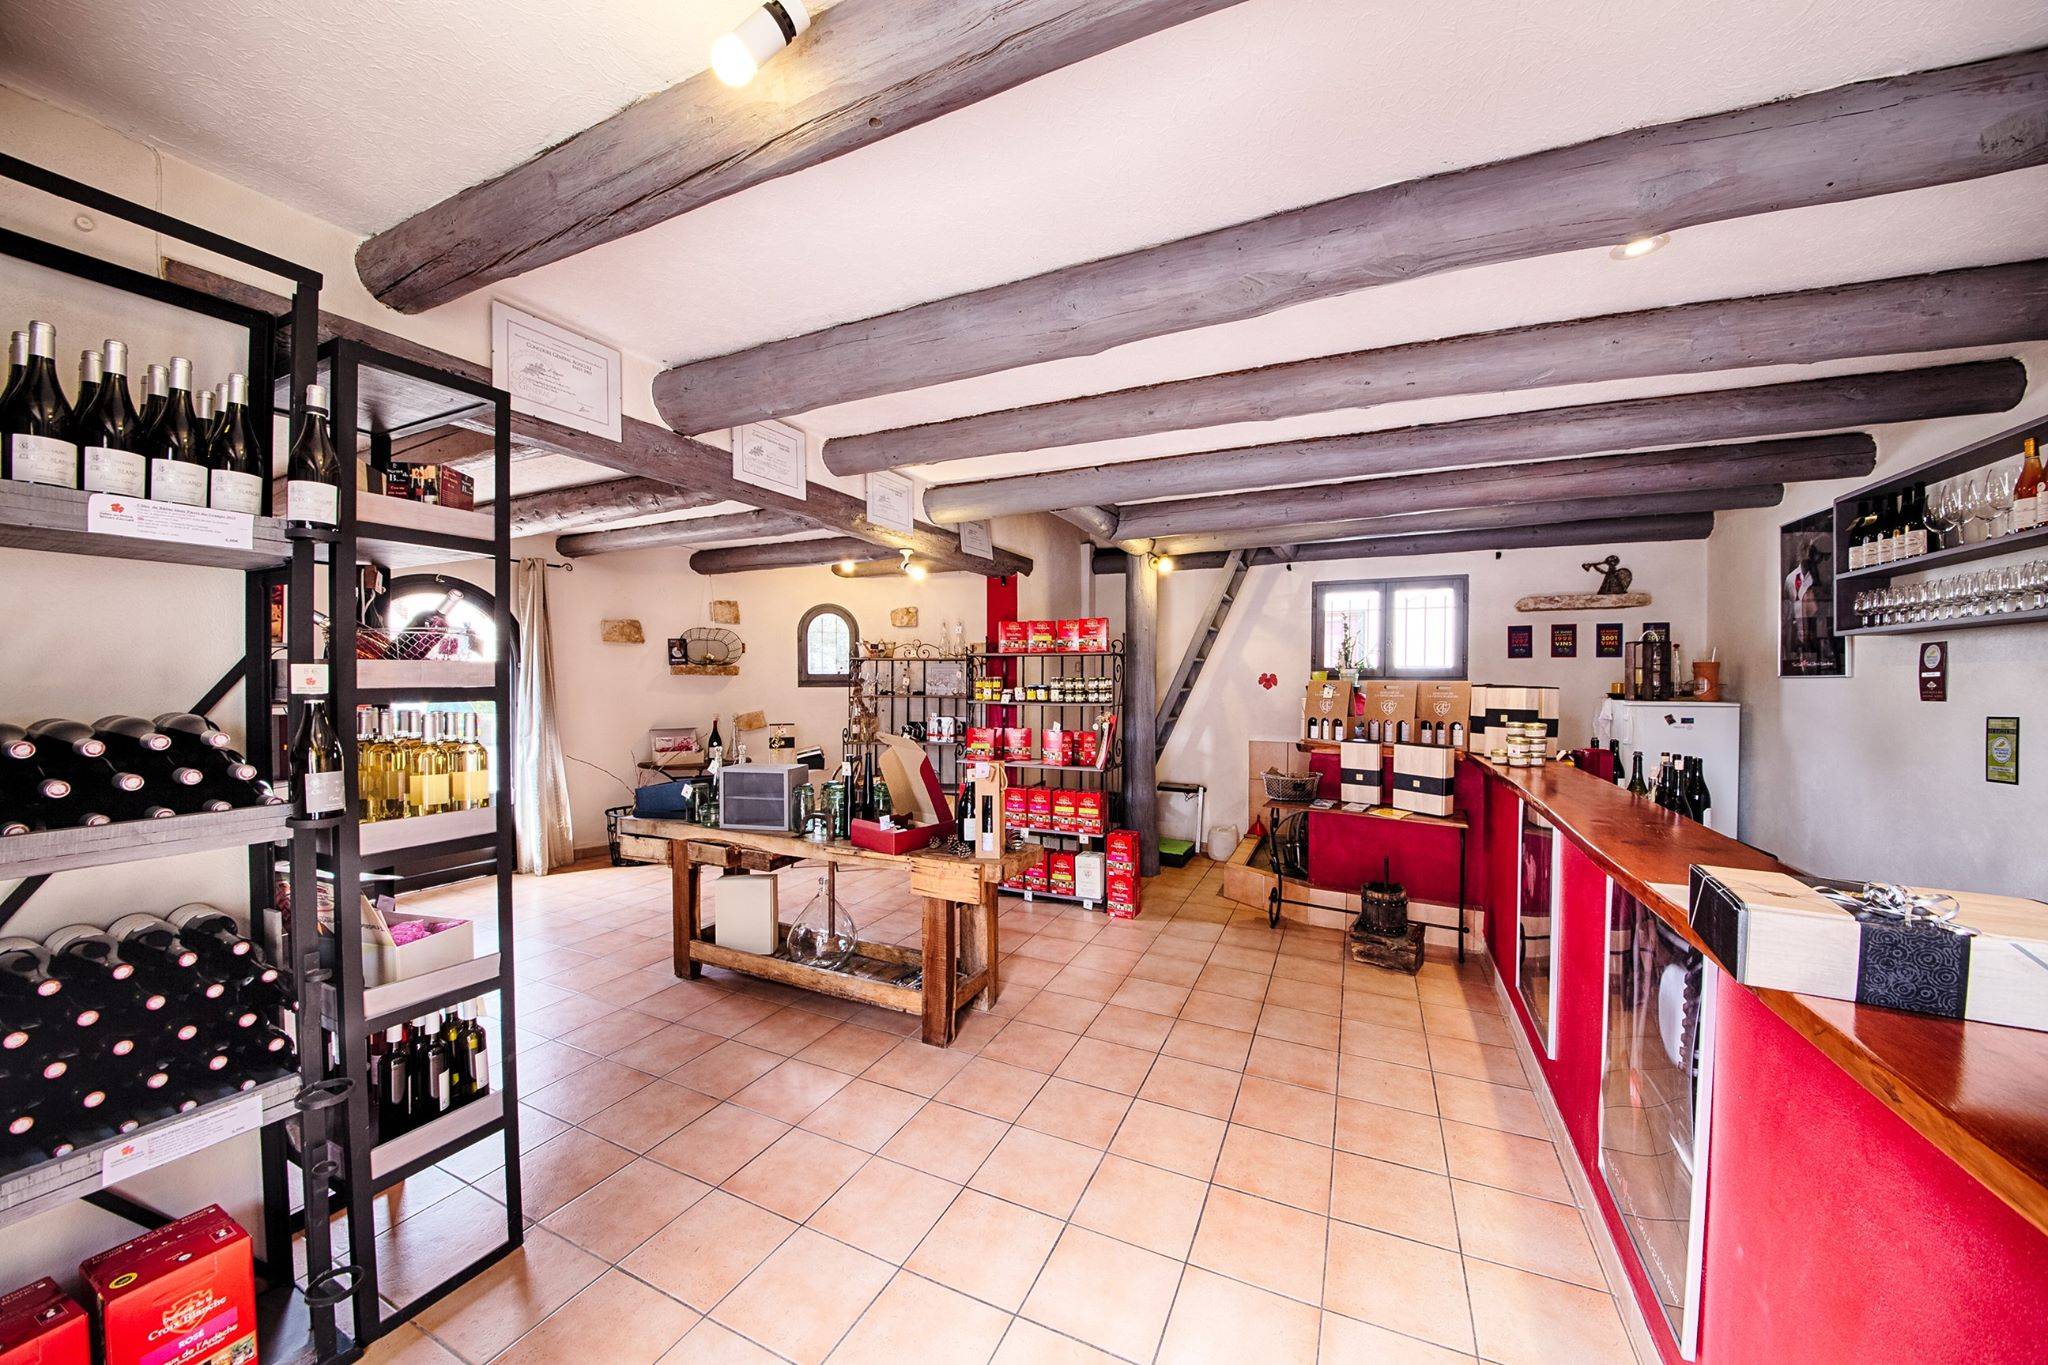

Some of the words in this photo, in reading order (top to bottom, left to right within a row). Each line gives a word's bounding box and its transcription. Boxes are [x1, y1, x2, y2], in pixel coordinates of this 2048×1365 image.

[148, 1319, 181, 1342] Croix
[183, 1296, 227, 1323] Blanche
[178, 1329, 205, 1349] ROSÉ
[181, 1348, 195, 1359] de
[196, 1324, 239, 1350] l'Ardèche
